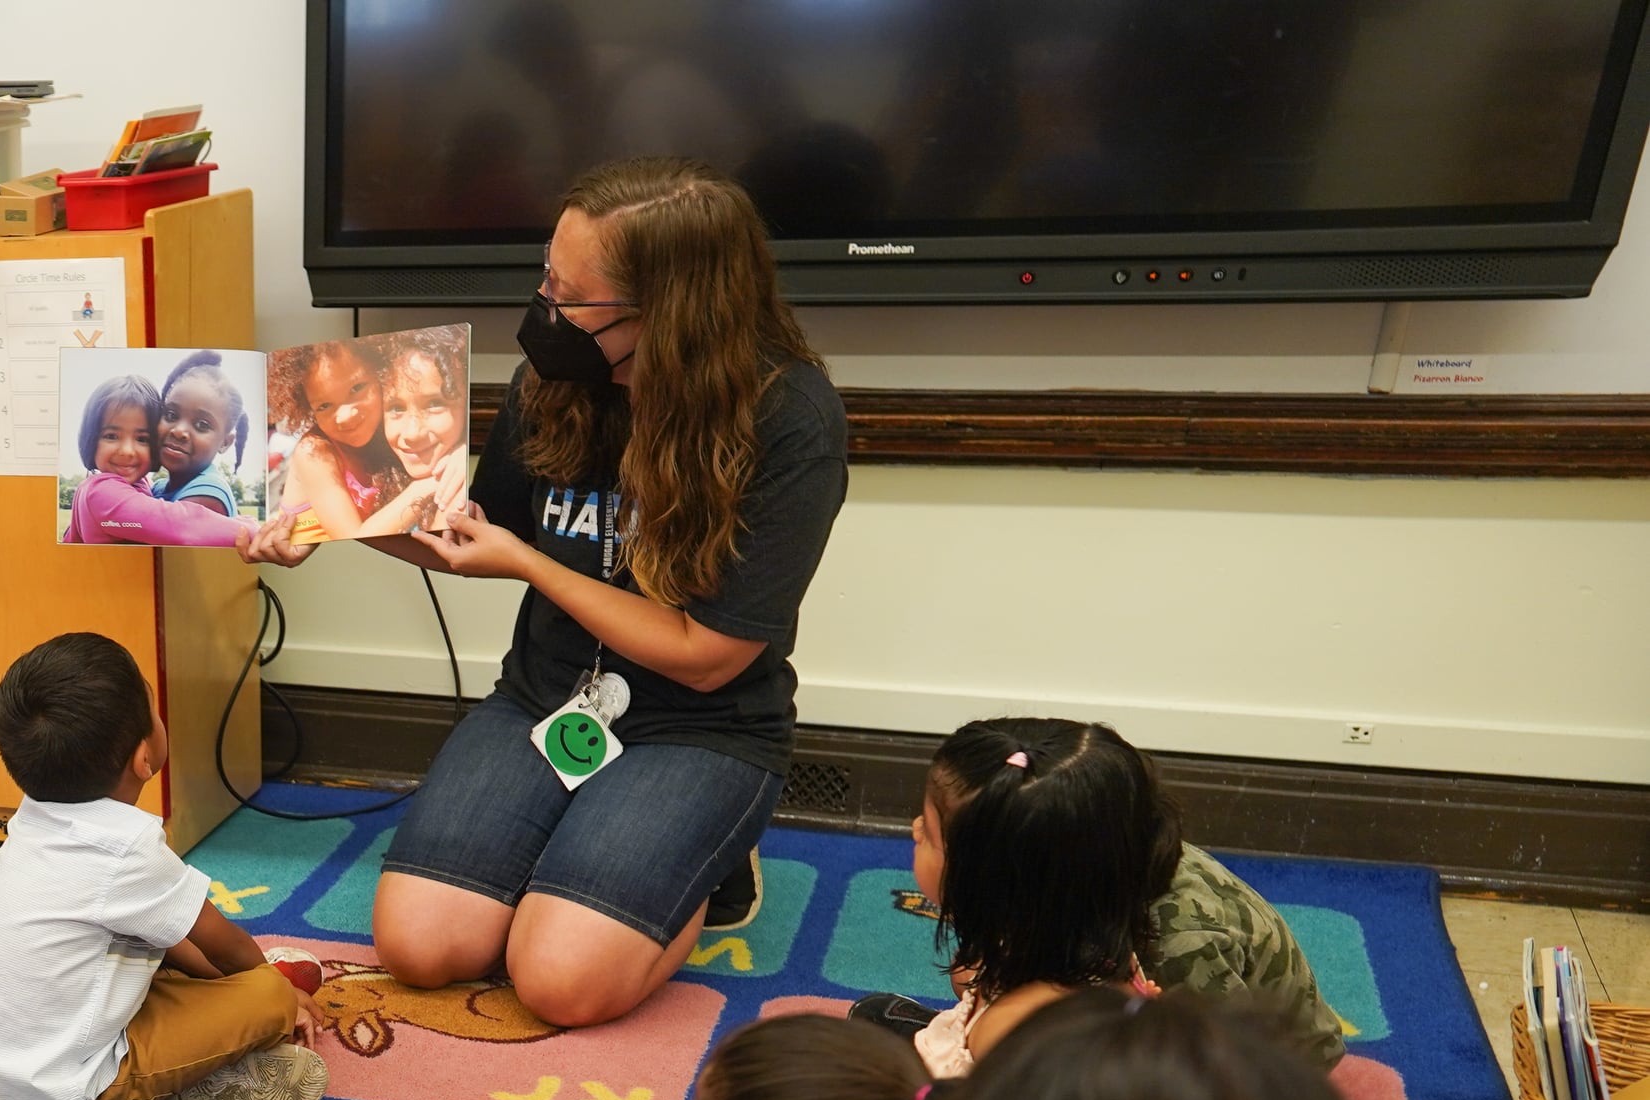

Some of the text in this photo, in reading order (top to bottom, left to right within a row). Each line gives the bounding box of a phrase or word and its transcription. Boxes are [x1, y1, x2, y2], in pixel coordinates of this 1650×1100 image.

[848, 242, 915, 255] Promethean
[15, 271, 86, 284] Circle Time Rules
[1417, 359, 1472, 368] Whiteboard
[0, 371, 6, 383] 3
[1, 404, 9, 416] 4
[4, 437, 11, 449] 5
